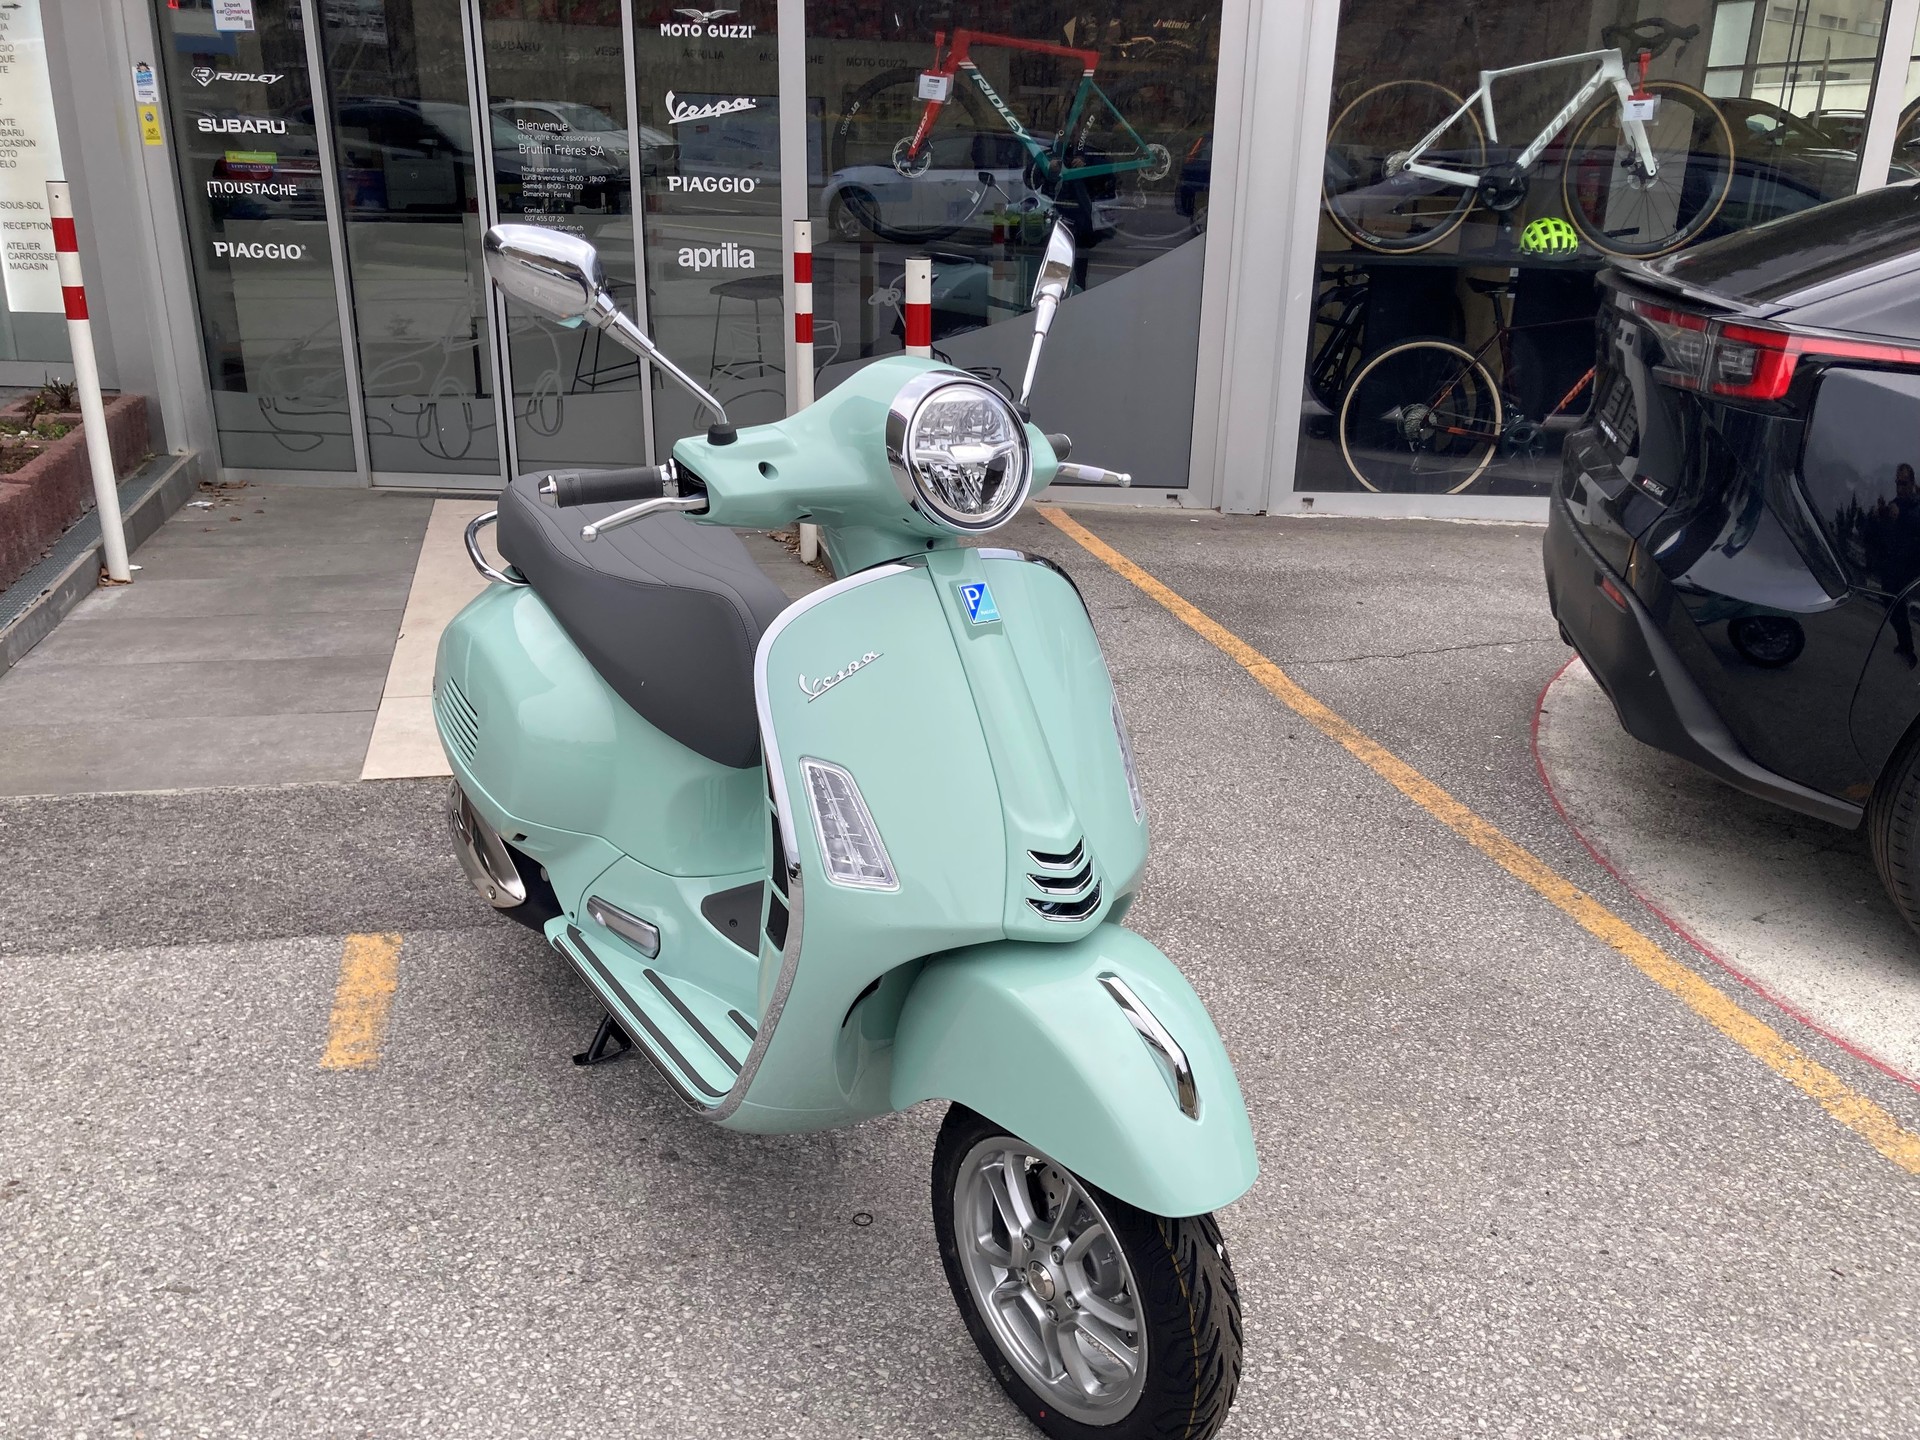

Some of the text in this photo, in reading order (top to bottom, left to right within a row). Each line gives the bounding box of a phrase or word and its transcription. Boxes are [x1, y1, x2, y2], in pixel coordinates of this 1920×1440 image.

[660, 23, 753, 39] MOTO GUZZI
[215, 72, 284, 84] RIDLEY
[665, 90, 757, 125] Vespa
[971, 73, 1032, 140] RIDLEY
[1526, 67, 1605, 162] RIDLEY
[197, 118, 286, 134] SUBARU
[516, 119, 569, 132] Bienvenue
[911, 111, 929, 149] RIDLEY
[518, 143, 605, 156] Bruttin Frères SA
[521, 165, 535, 173] Nous
[666, 176, 755, 194] PIAGGIO
[523, 190, 550, 198] Dimanche
[524, 206, 545, 214] Contact
[3, 221, 53, 230] RECEPTION
[557, 215, 565, 223] 20
[6, 242, 41, 250] ATELIER
[212, 241, 302, 260] PIAGGIO
[8, 252, 57, 260] CARROSSE
[677, 242, 756, 272] aprilia
[9, 262, 49, 270] MAGASIN
[963, 587, 981, 610] P
[797, 650, 884, 704] Vespa
